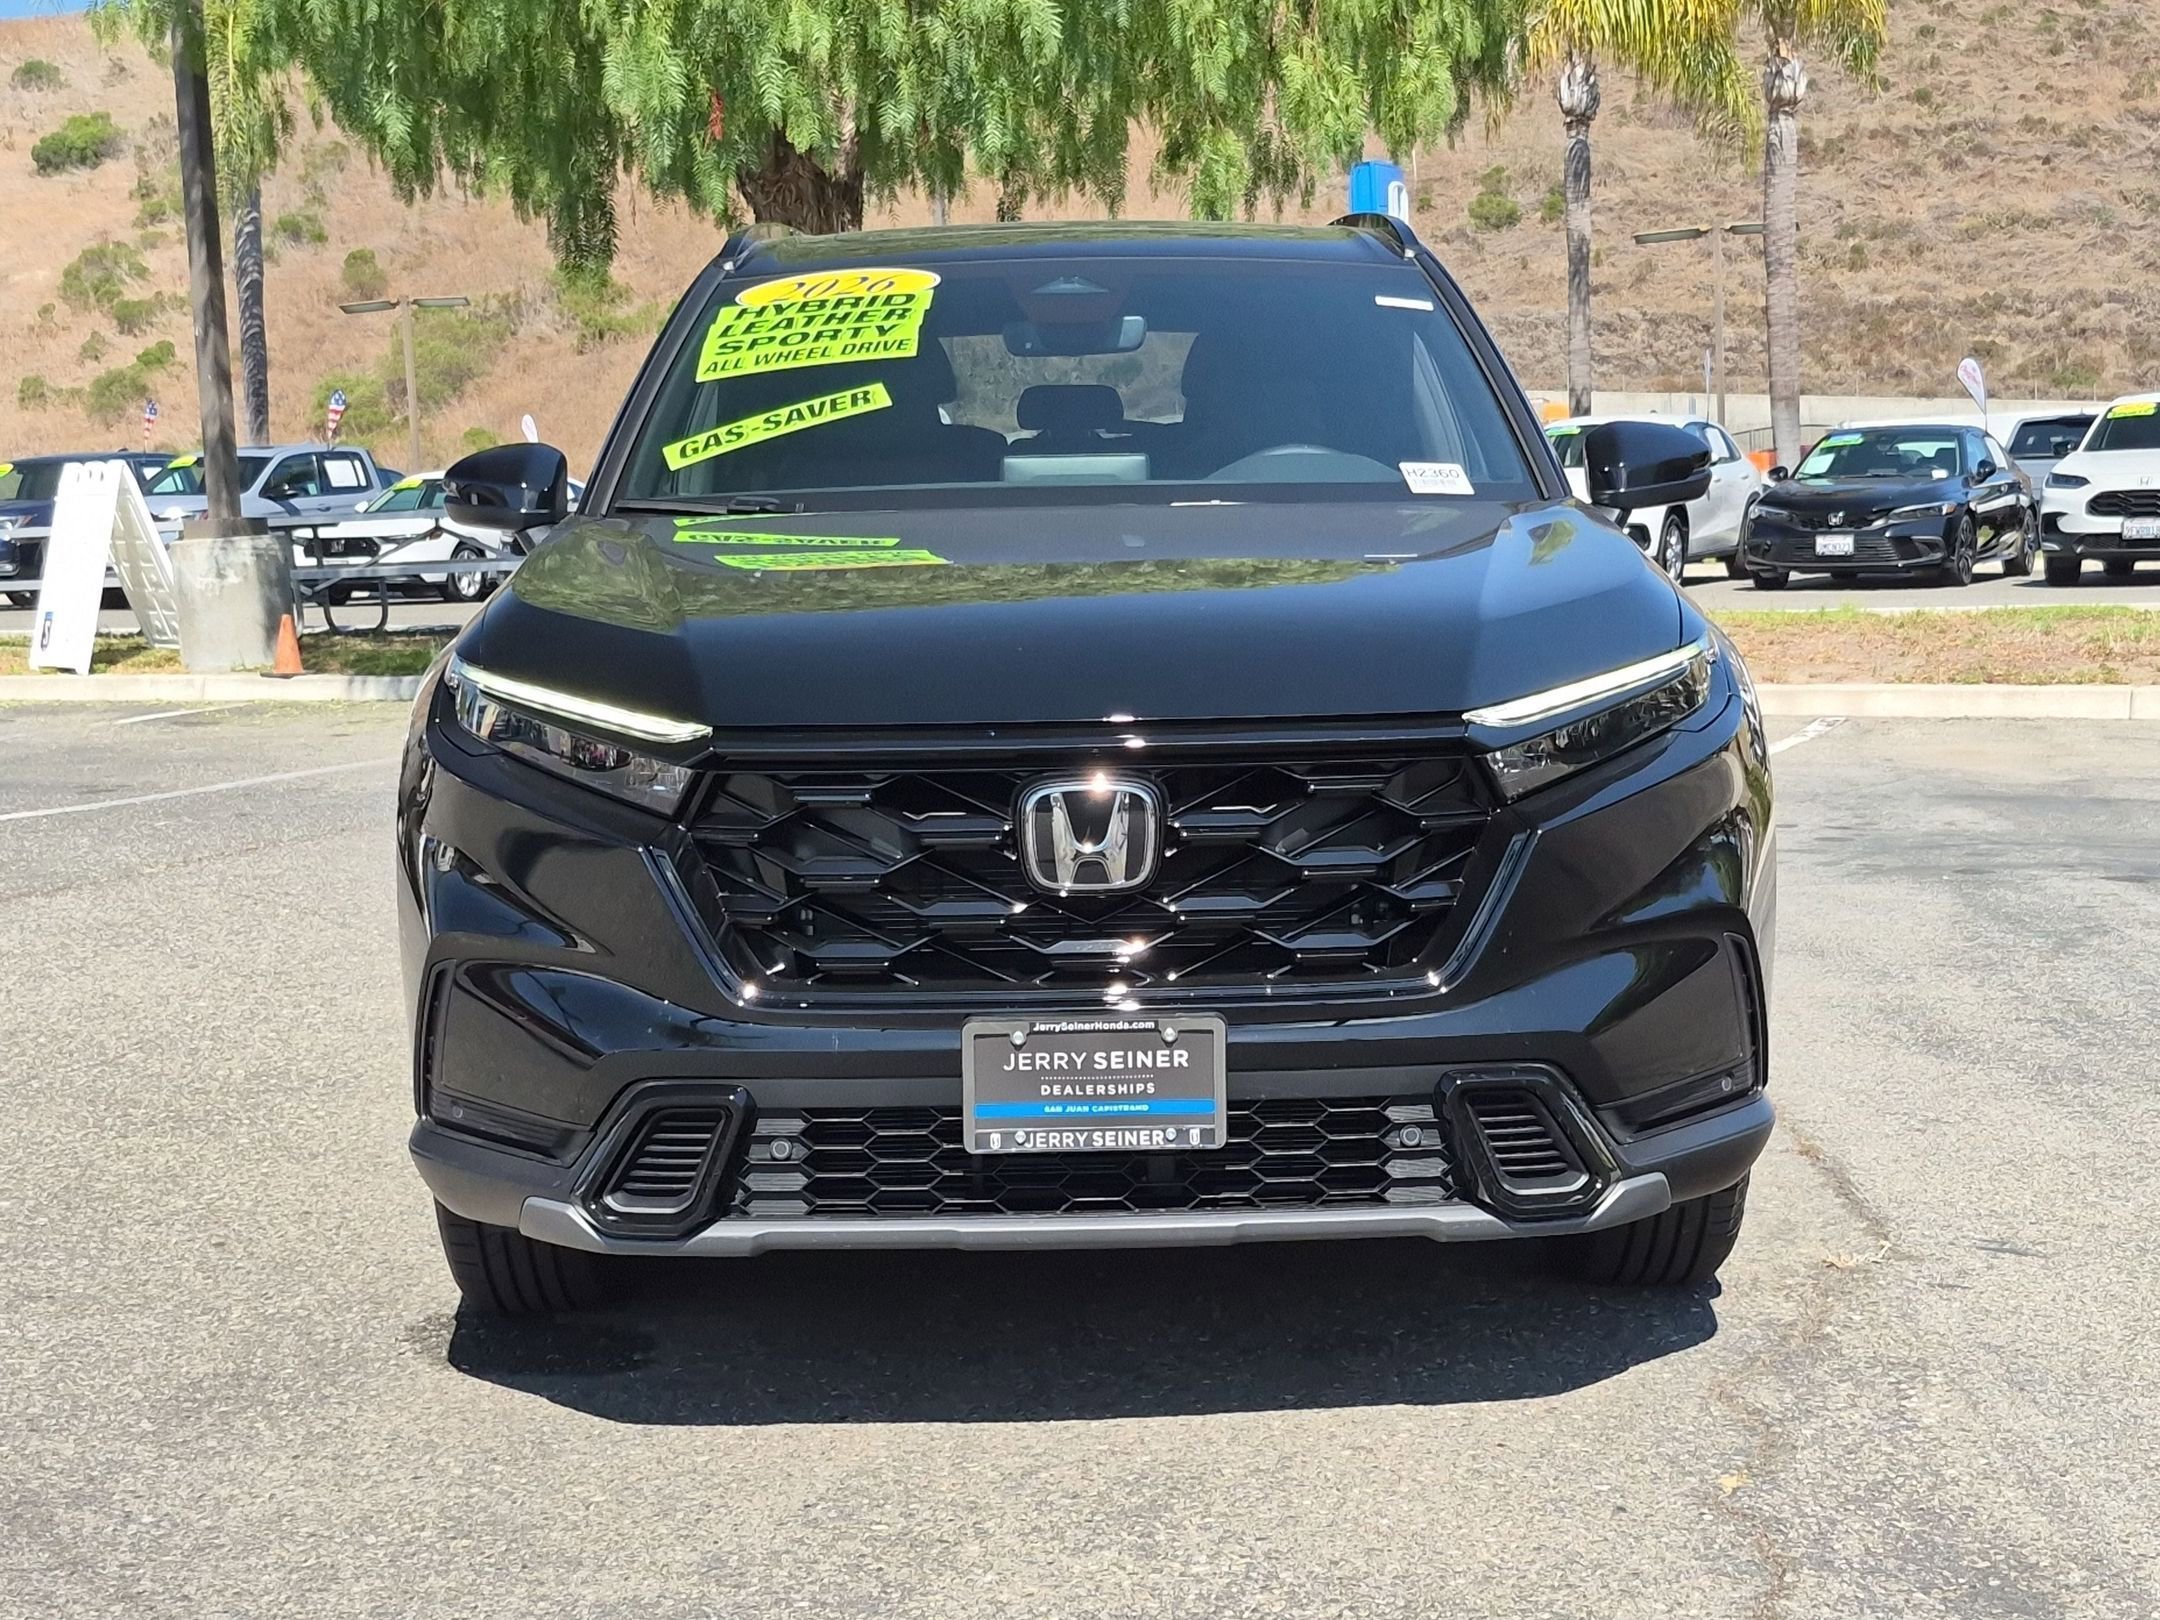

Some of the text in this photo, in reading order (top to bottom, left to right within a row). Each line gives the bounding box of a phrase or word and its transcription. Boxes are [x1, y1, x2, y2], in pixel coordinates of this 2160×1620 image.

[770, 273, 904, 302] 2026
[733, 292, 917, 321] HYBRID
[717, 307, 912, 339] LEATHER
[714, 323, 902, 356] SPORTY
[702, 338, 911, 375] ALL WHEEL DRIVE
[679, 389, 872, 459] GAS-SAVER
[1405, 467, 1460, 479] H2360
[1032, 1020, 1156, 1033] JerrySeinerHonda.com
[1003, 1049, 1189, 1071] JERRY SEINER
[1040, 1082, 1156, 1096] DEALERSHIPS
[1024, 1129, 1165, 1148] JERRY SEINER
